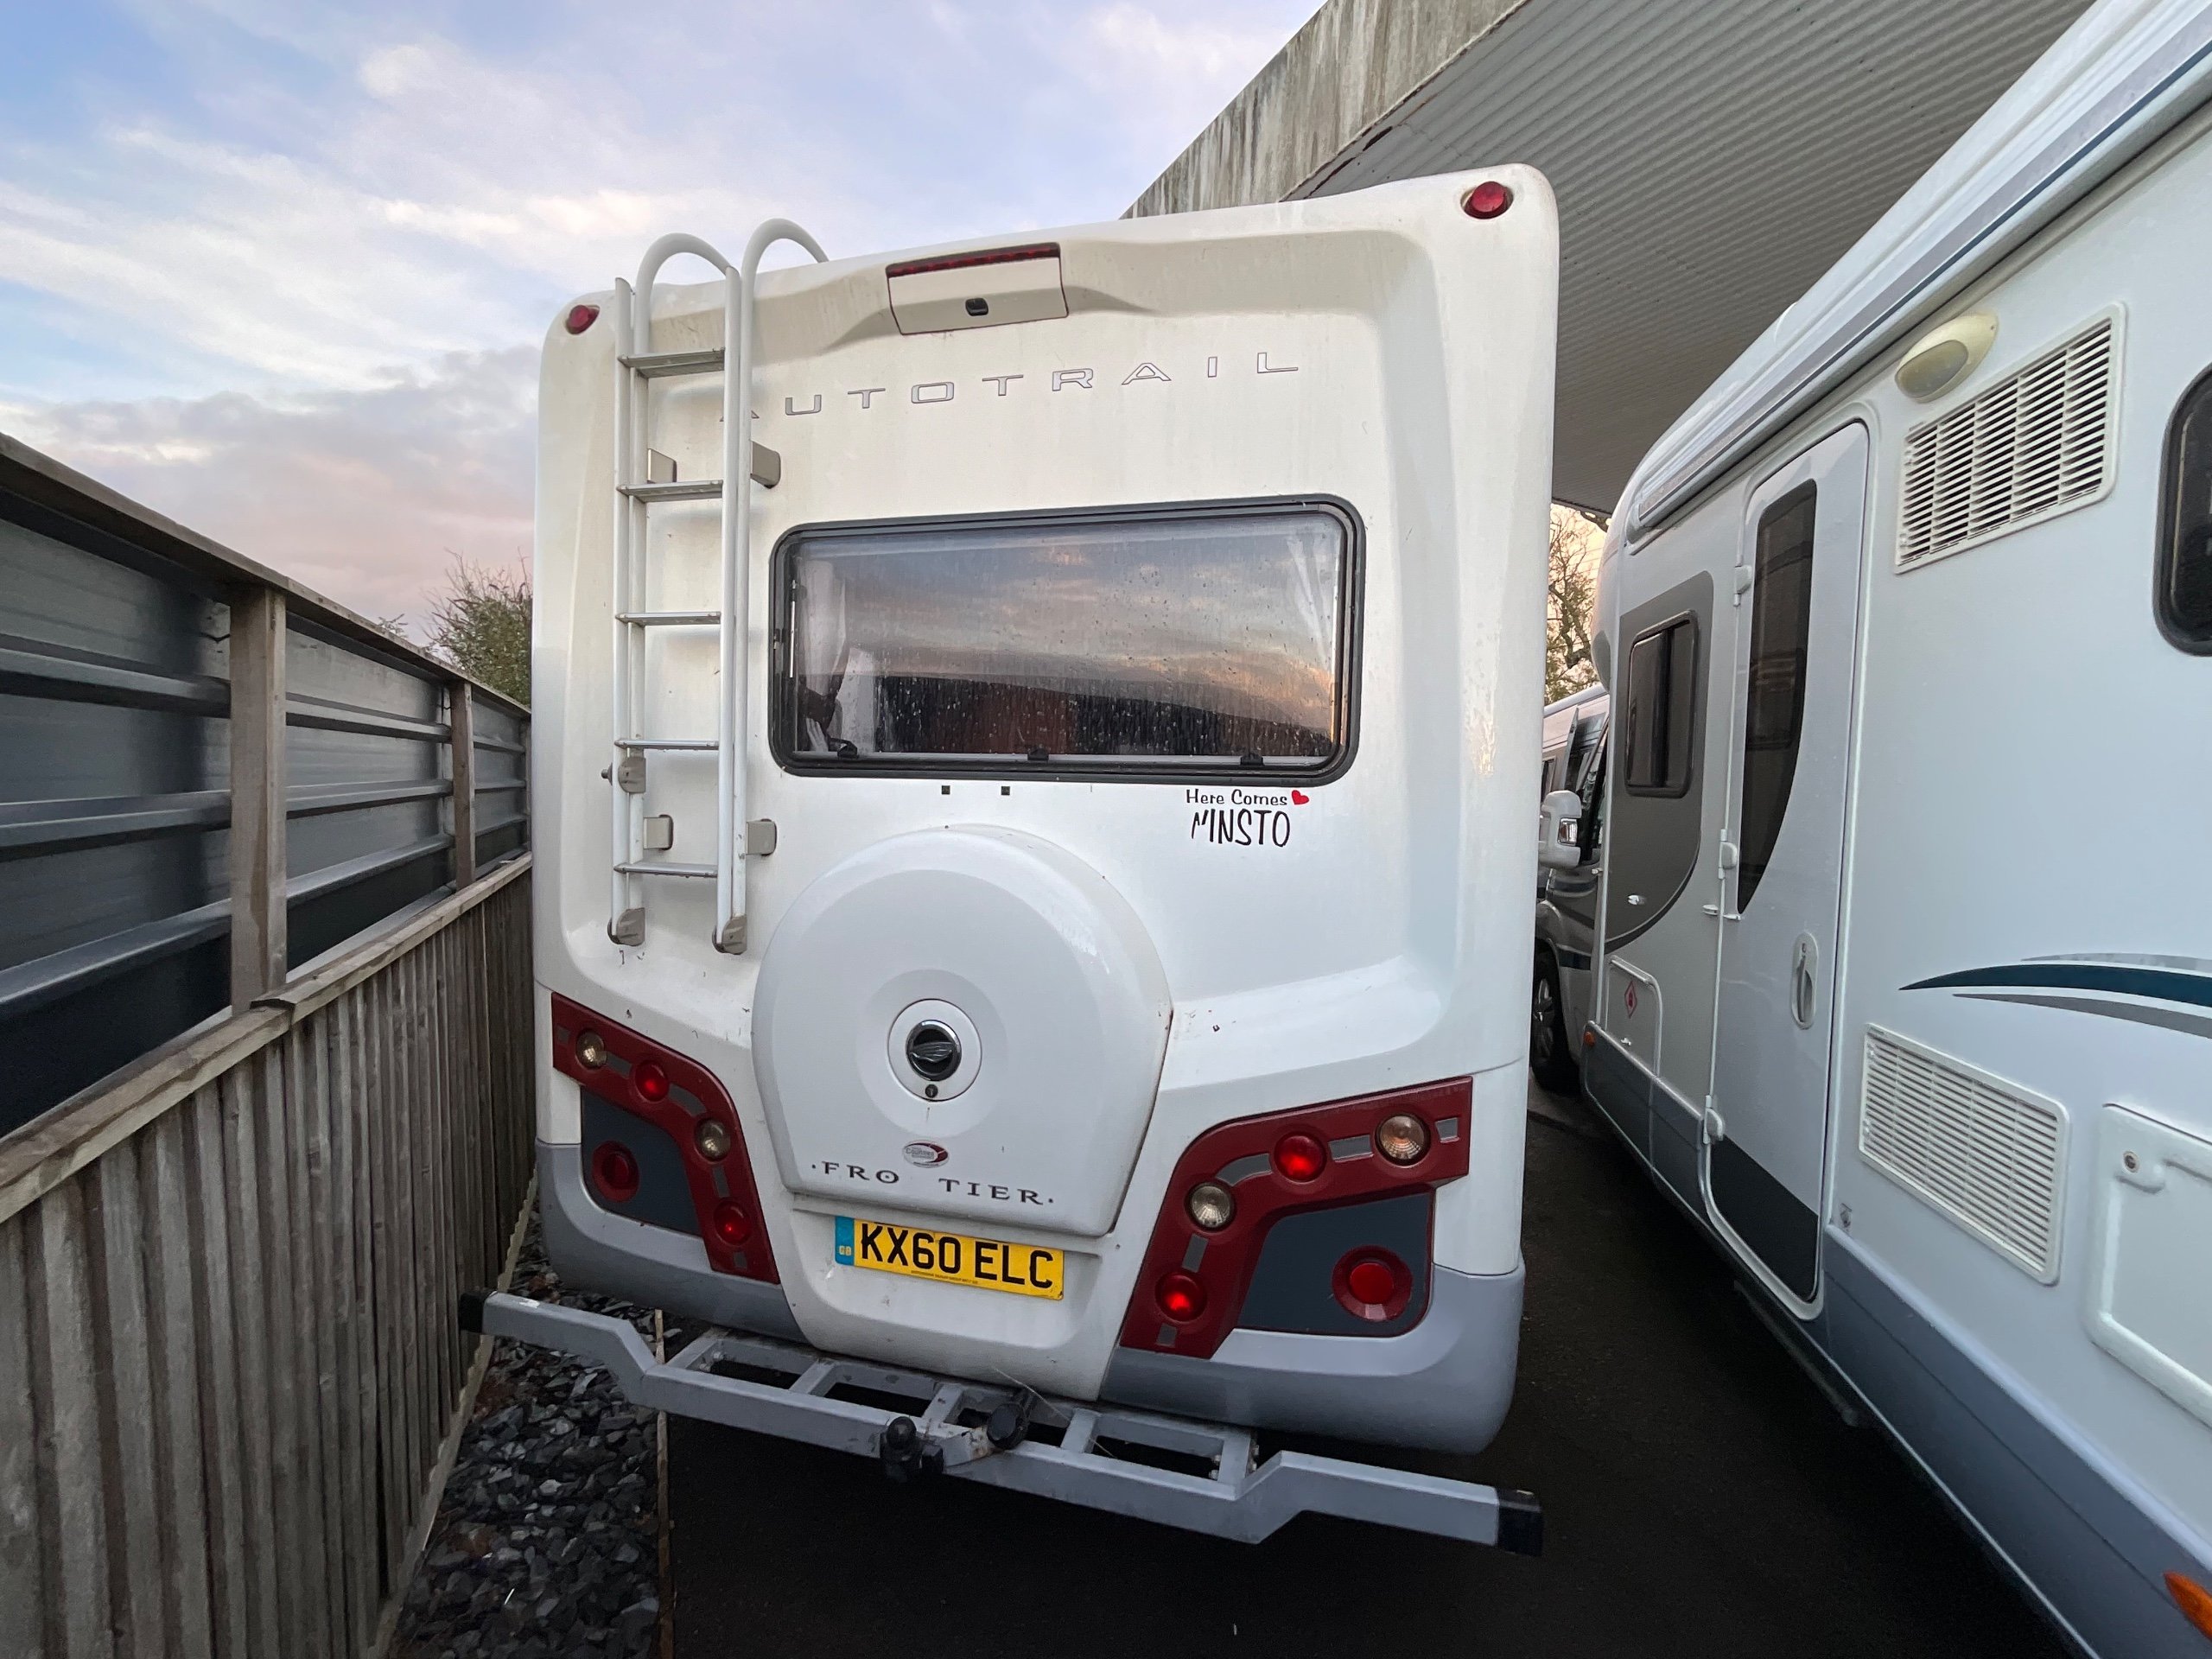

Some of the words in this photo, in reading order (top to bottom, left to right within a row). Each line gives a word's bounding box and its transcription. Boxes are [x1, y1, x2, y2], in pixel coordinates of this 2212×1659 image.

[1185, 788, 1225, 804] Here
[1230, 788, 1288, 806] Comes
[1191, 808, 1291, 848] MINSTO
[861, 1222, 963, 1274] KX60
[974, 1240, 1054, 1290] ELC
